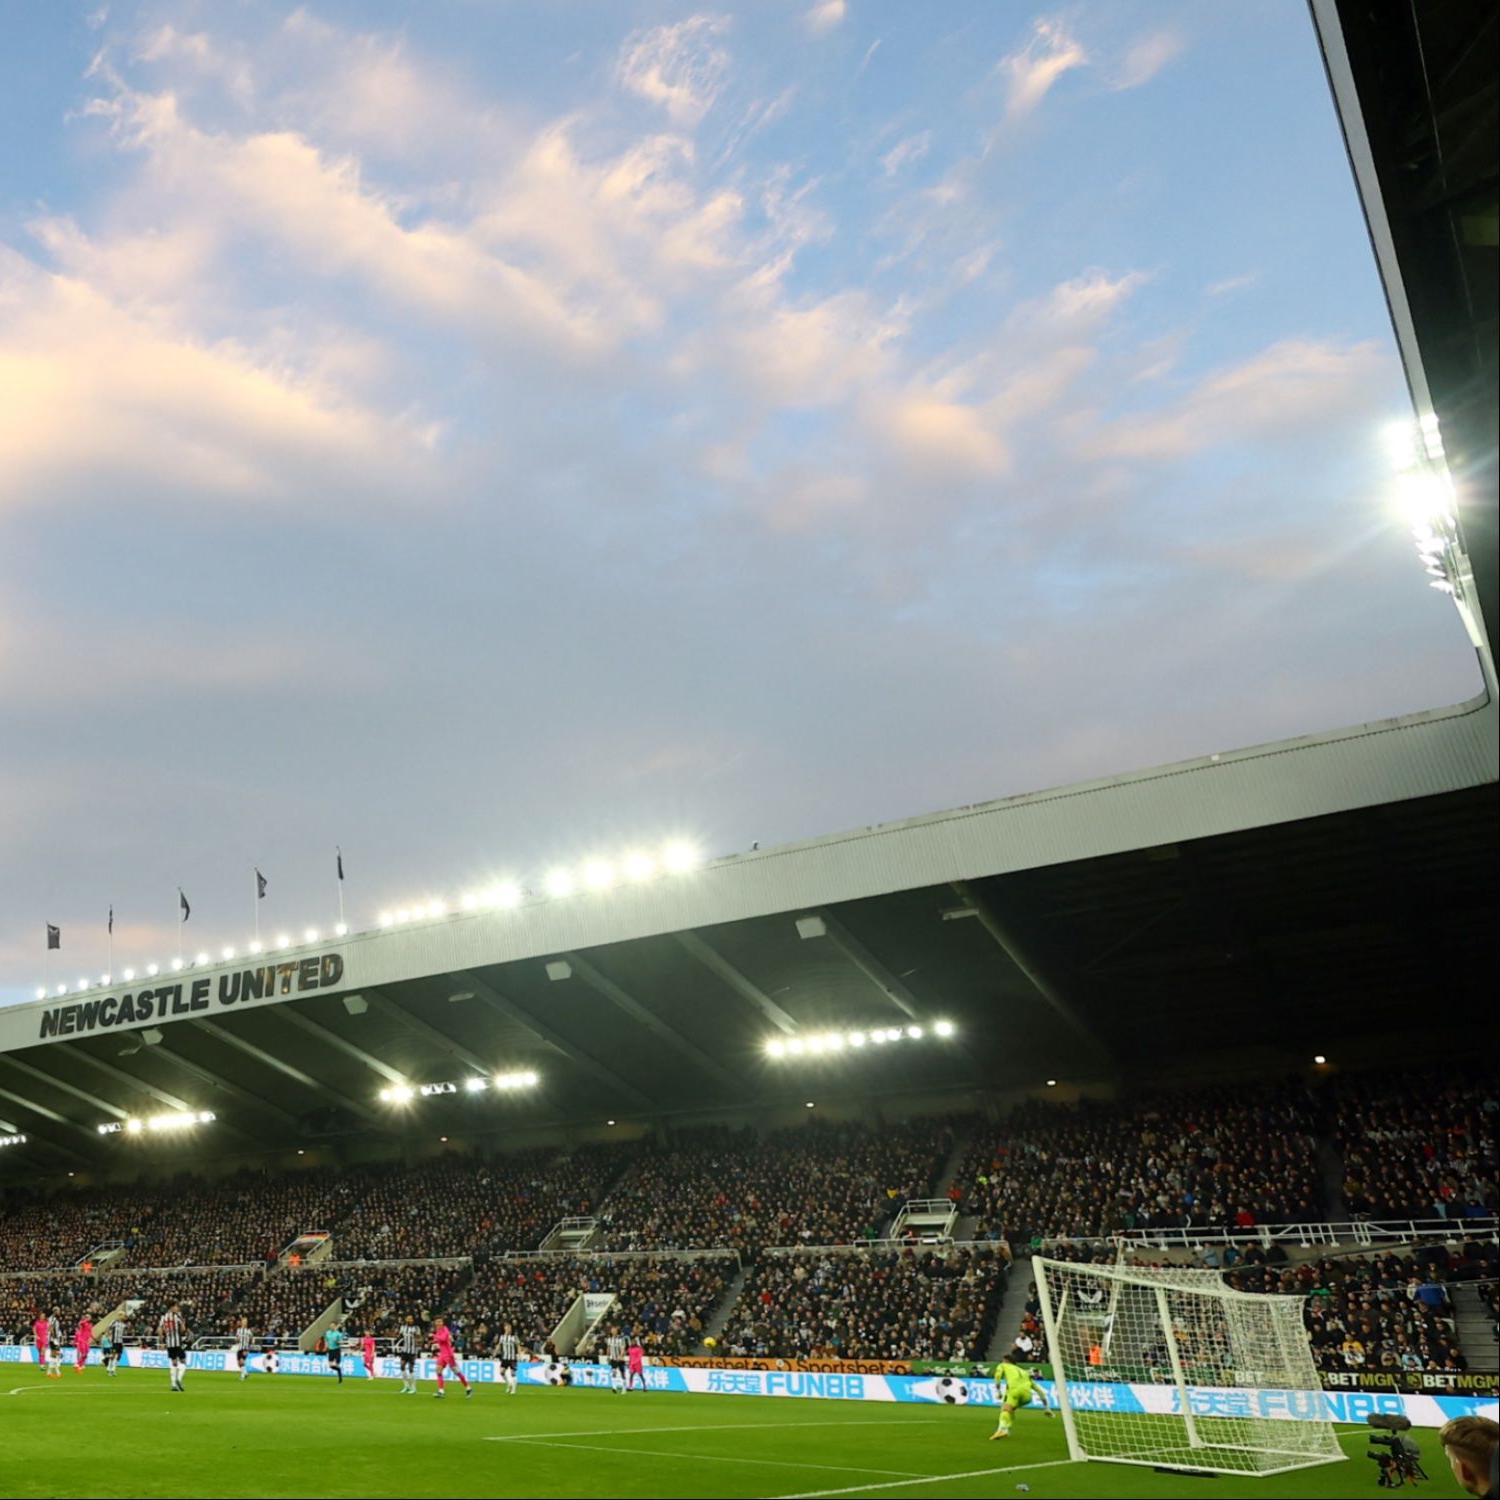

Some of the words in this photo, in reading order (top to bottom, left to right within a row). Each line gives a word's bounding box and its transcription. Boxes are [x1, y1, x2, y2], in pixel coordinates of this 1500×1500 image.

[40, 979, 211, 1038] NEWCASTLE
[218, 953, 344, 1004] UNITED
[671, 1357, 768, 1370] Sportsbeto
[797, 1359, 907, 1374] Sportsbeto
[766, 1373, 865, 1399] FUN88
[1257, 1390, 1405, 1421] FUN88
